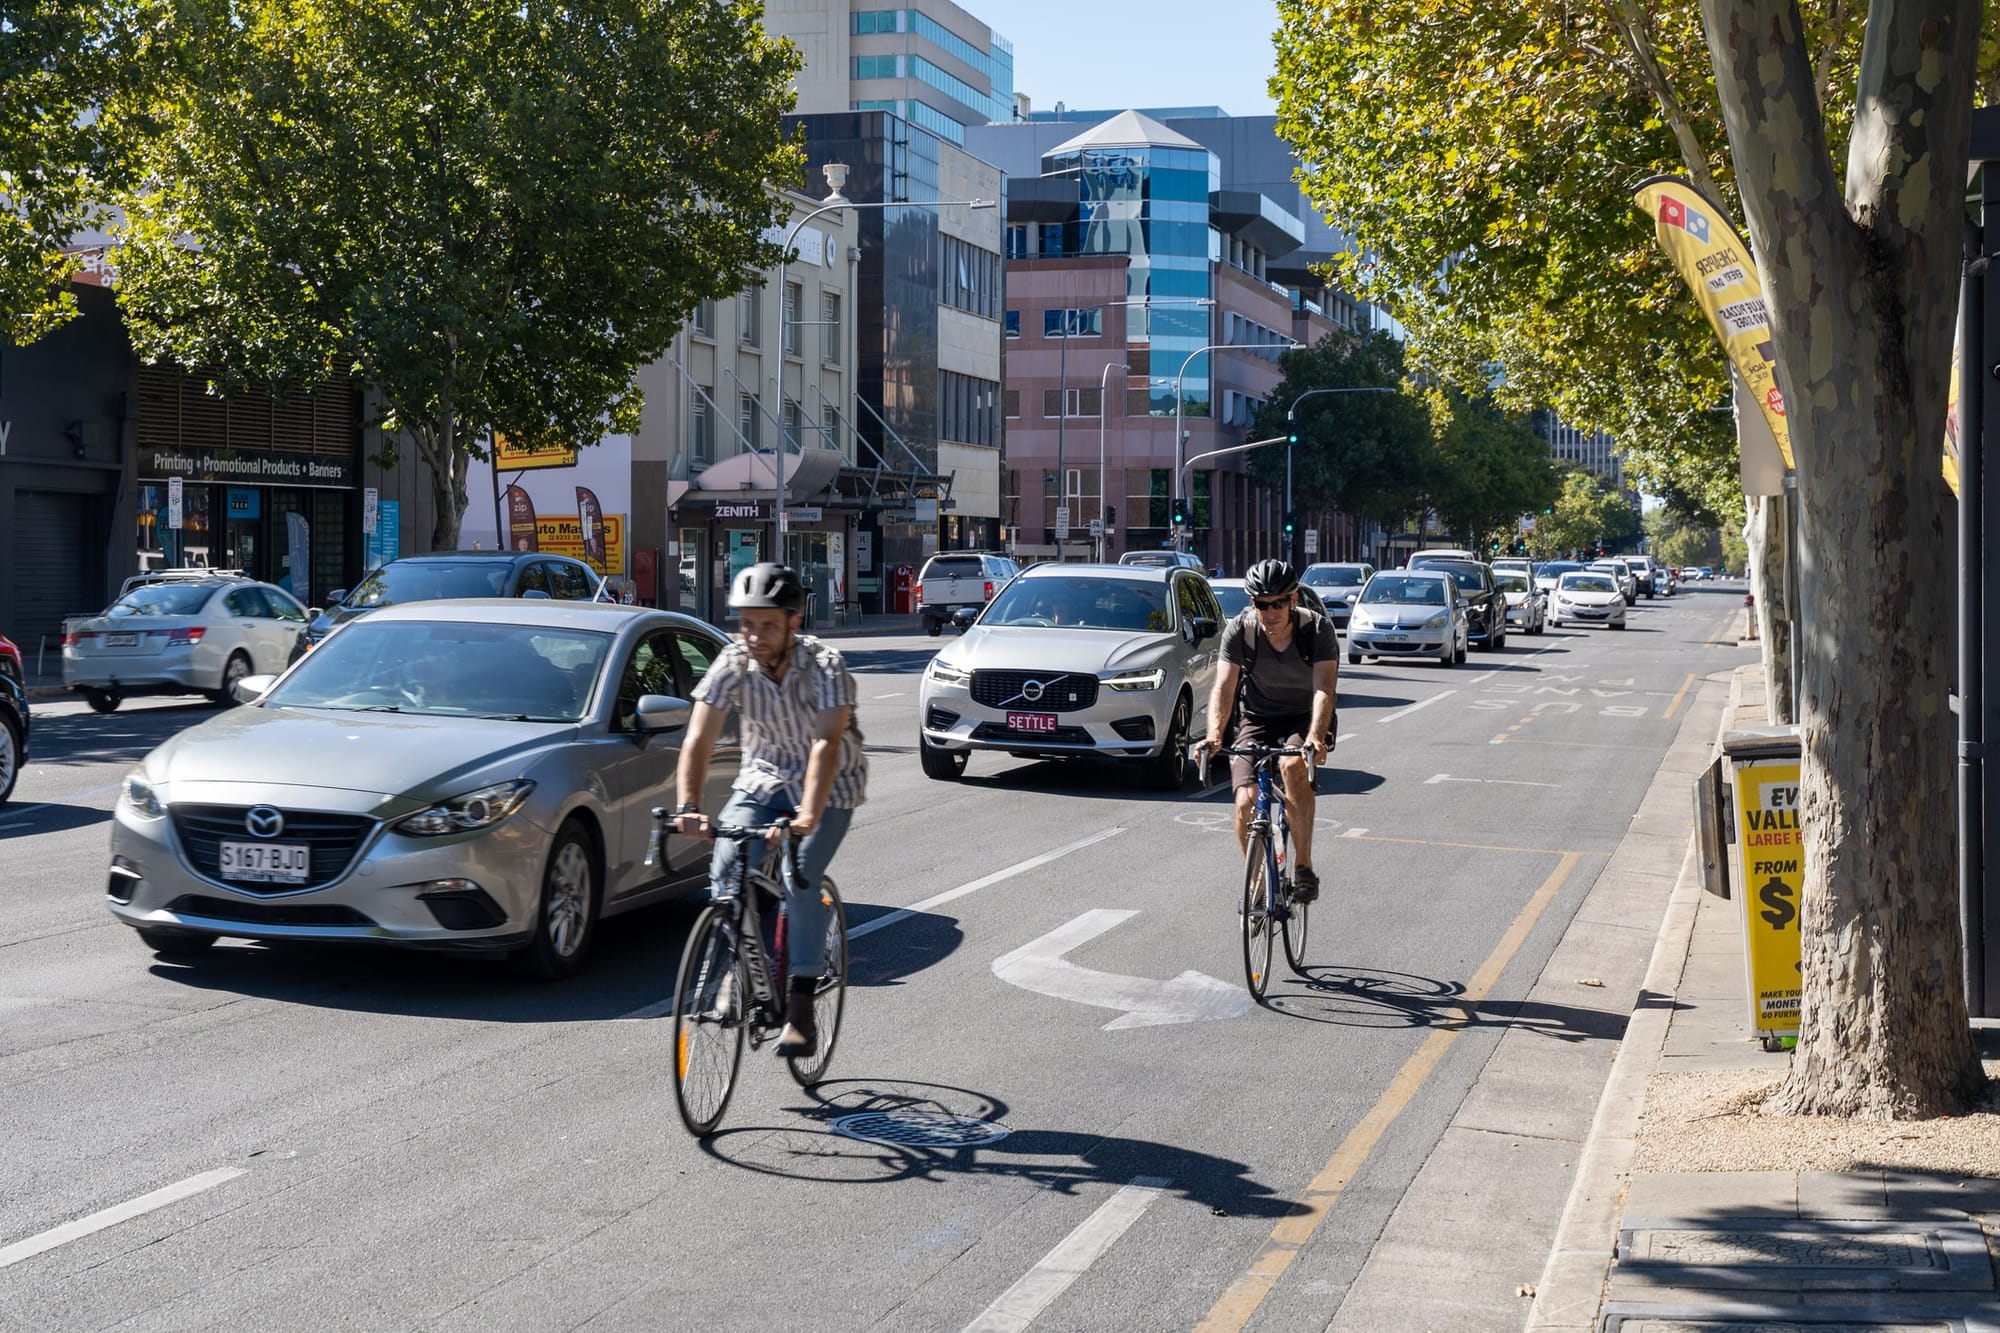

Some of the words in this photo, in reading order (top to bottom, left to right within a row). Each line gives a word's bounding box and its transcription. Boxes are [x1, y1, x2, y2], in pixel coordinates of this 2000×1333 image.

[154, 453, 193, 475] Printing
[203, 456, 261, 474] Promotional
[262, 458, 300, 476] Products
[309, 462, 342, 478] Banners
[513, 503, 527, 513] zip
[715, 506, 759, 517] ZENITH
[536, 524, 556, 534] uto
[1467, 699, 1649, 718] BUS
[1008, 715, 1055, 730] SETTLE
[1771, 787, 1800, 807] EV
[1746, 832, 1791, 847] LARGE
[1754, 860, 1798, 875] FROM
[1760, 990, 1783, 999] MAKE
[1766, 999, 1802, 1010] MONEY
[1762, 1011, 1772, 1019] GO
